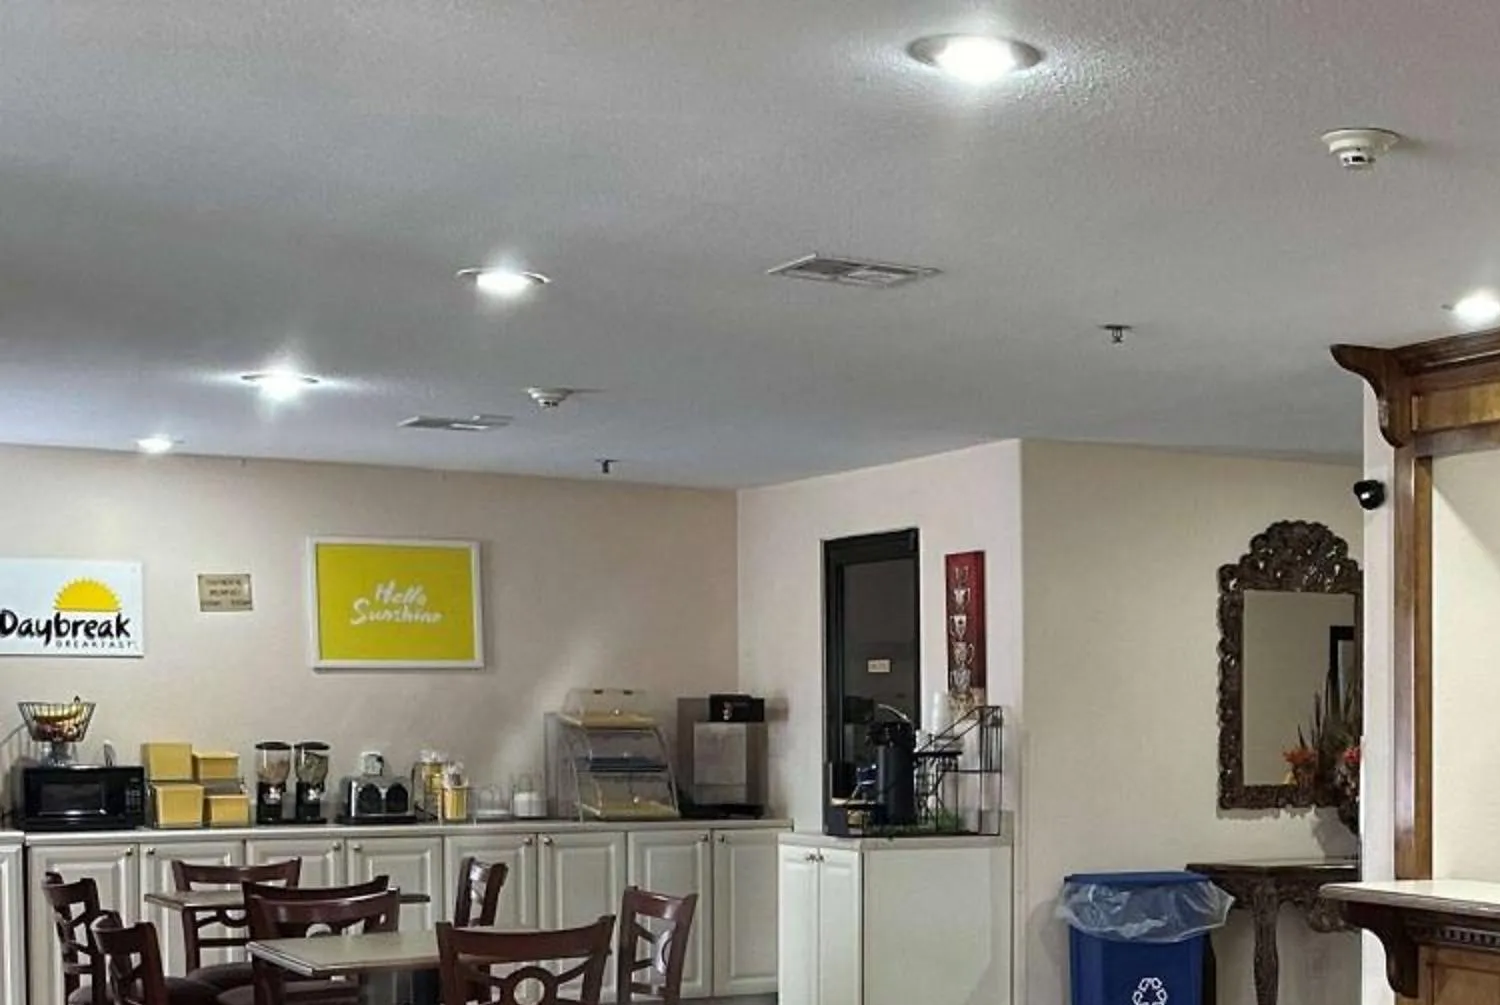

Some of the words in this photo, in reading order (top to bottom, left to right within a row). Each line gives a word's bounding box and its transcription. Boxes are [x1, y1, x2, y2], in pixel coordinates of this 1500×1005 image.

[375, 579, 427, 606] Hello
[350, 597, 443, 625] Sunshine
[0, 608, 131, 646] Daybreak
[56, 640, 132, 649] BREAKFAST
